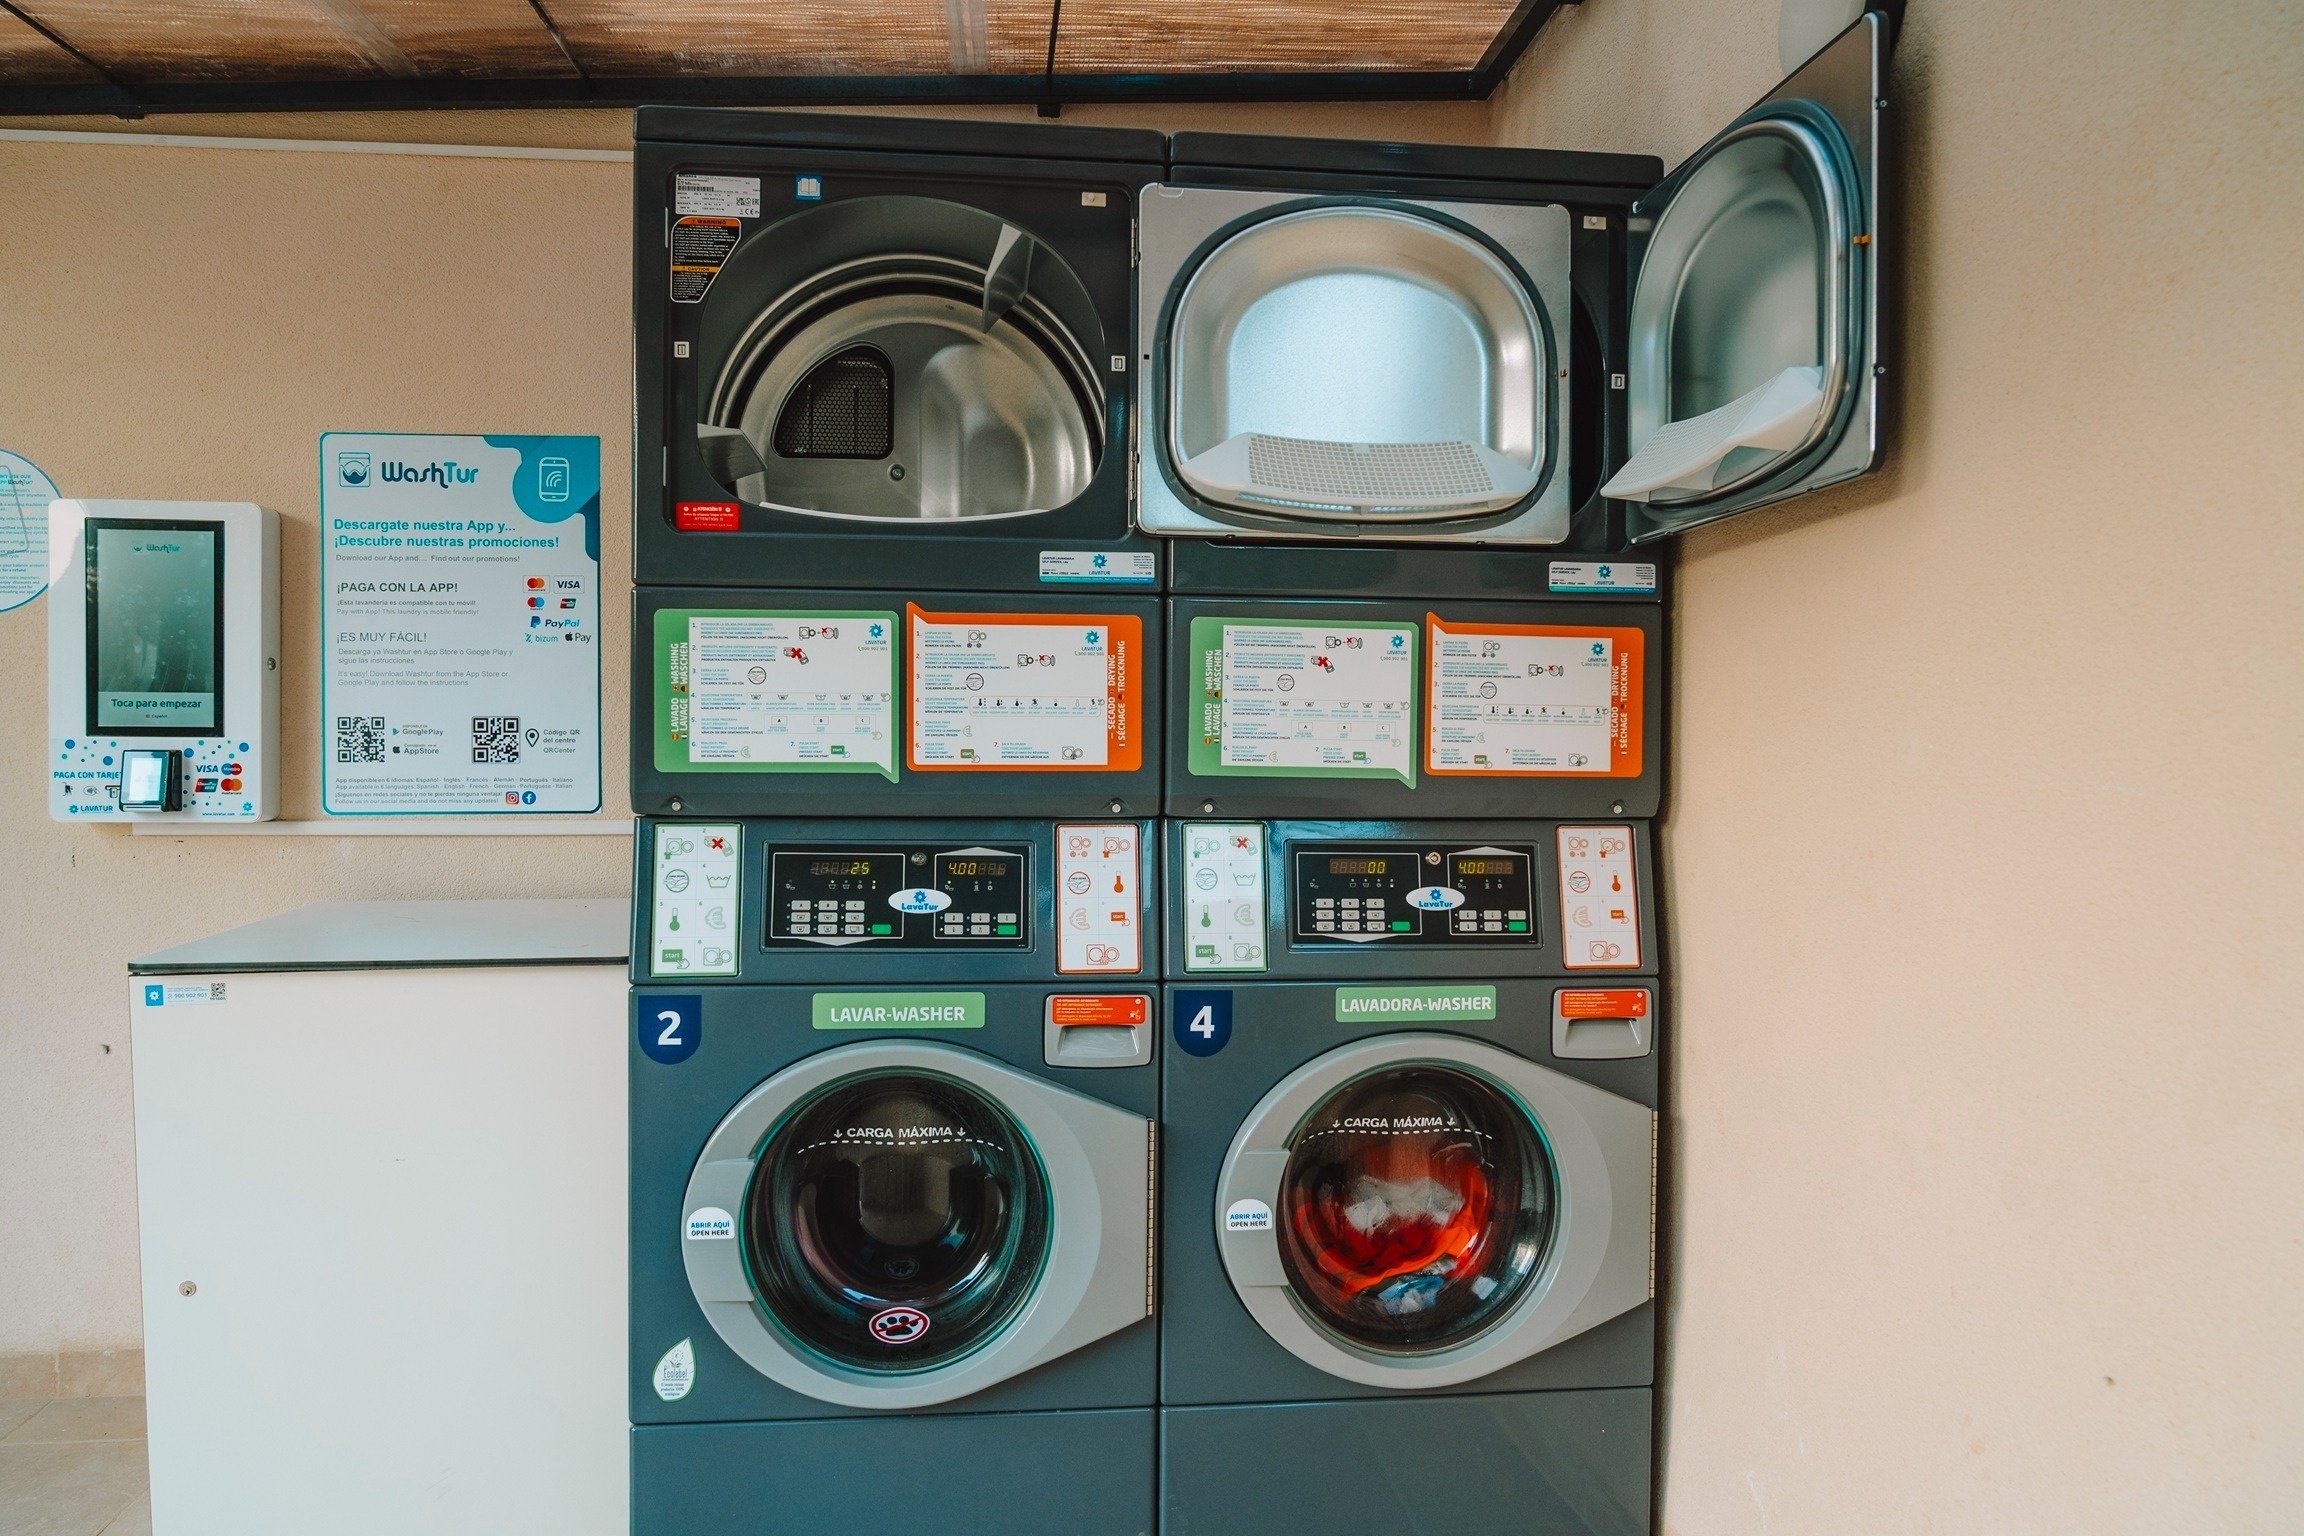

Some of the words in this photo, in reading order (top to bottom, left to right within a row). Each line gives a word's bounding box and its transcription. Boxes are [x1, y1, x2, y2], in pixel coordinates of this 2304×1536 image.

[381, 462, 479, 489] WashTur
[334, 519, 409, 533] Descargate
[414, 521, 463, 532] nuestra
[467, 520, 494, 534] App
[498, 522, 516, 534] y...
[335, 535, 403, 549] ¡Descubre
[407, 537, 464, 547] nuestras
[469, 537, 559, 550] promociones!
[147, 544, 180, 554] WashTur
[388, 555, 403, 563] App
[476, 556, 520, 564] promotions!
[337, 583, 376, 594] ¡PAGA
[380, 583, 406, 592] CON
[410, 583, 425, 592] LA
[430, 583, 458, 592] APP!
[557, 581, 580, 589] VISA
[545, 619, 580, 628] PayPal
[337, 633, 356, 644] ¡ES
[360, 633, 386, 642] MUY
[390, 632, 427, 642] FÁCIL!
[536, 635, 558, 643] bizum
[575, 633, 592, 644] Pay
[671, 643, 679, 684] WASHING
[1108, 655, 1116, 686] DRYING
[111, 699, 134, 708] Toca
[136, 700, 158, 710] para
[160, 700, 202, 711] empezar
[671, 698, 679, 732] LAVADO
[680, 698, 688, 731] LAVAGE
[1108, 697, 1116, 730] SECADO
[1117, 703, 1126, 740] SÉCHAGE
[196, 765, 219, 773] VISA
[97, 772, 122, 780] TARJE
[851, 862, 869, 875] 25
[901, 903, 939, 911] LavaTur
[1341, 996, 1492, 1013] LAVADORA-WASHER
[830, 1007, 965, 1023] LAVAR-WASHER
[657, 1010, 682, 1046] 2
[1190, 1006, 1215, 1039] 4
[1344, 1118, 1389, 1128] CARGA
[1393, 1116, 1443, 1128] MÁXIMA
[846, 1127, 894, 1139] CARGA
[898, 1126, 953, 1139] MÁXIMA
[1252, 1212, 1268, 1220] AQUÍ
[691, 1221, 712, 1230] ABRIR
[713, 1221, 730, 1229] AQUÍ
[664, 1368, 687, 1379] Ecolabel
